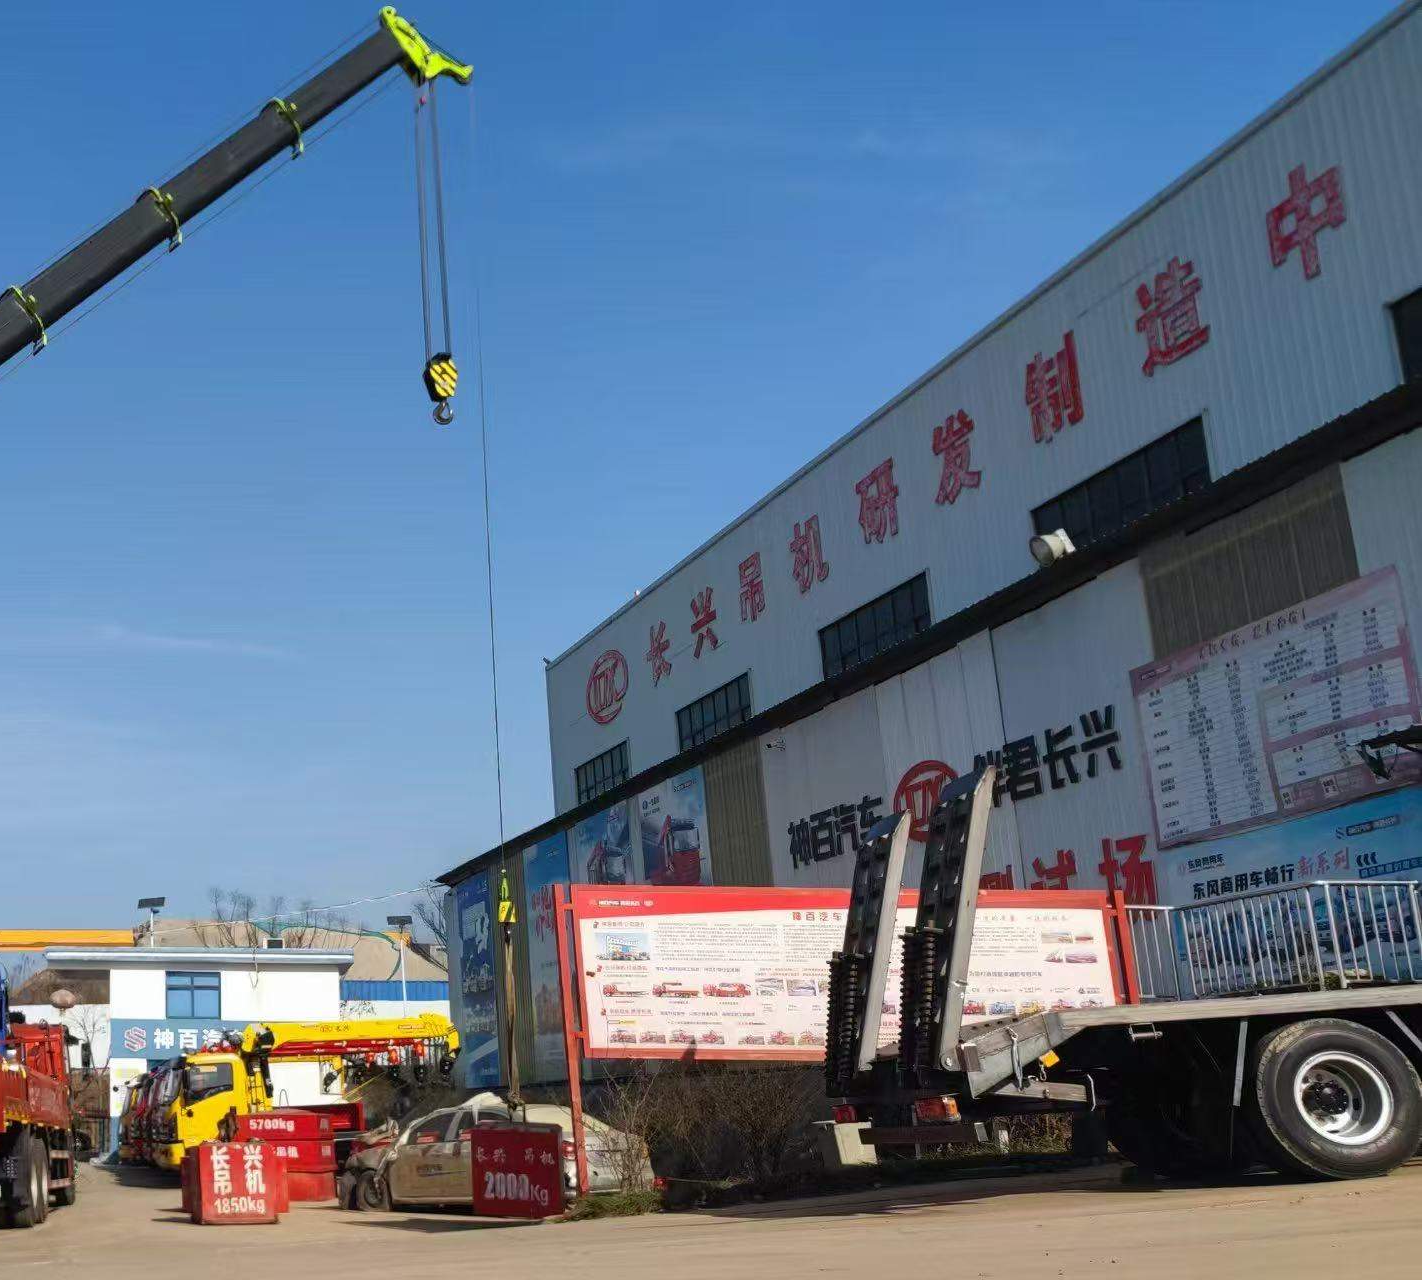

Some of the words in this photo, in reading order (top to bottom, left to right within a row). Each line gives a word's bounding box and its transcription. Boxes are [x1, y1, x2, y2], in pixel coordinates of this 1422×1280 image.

[153, 1027, 243, 1051] 神百汽
[249, 1117, 295, 1132] 5700kg
[210, 1145, 264, 1170] 长兴
[213, 1169, 266, 1195] 吊机
[214, 1196, 266, 1215] 1850kg
